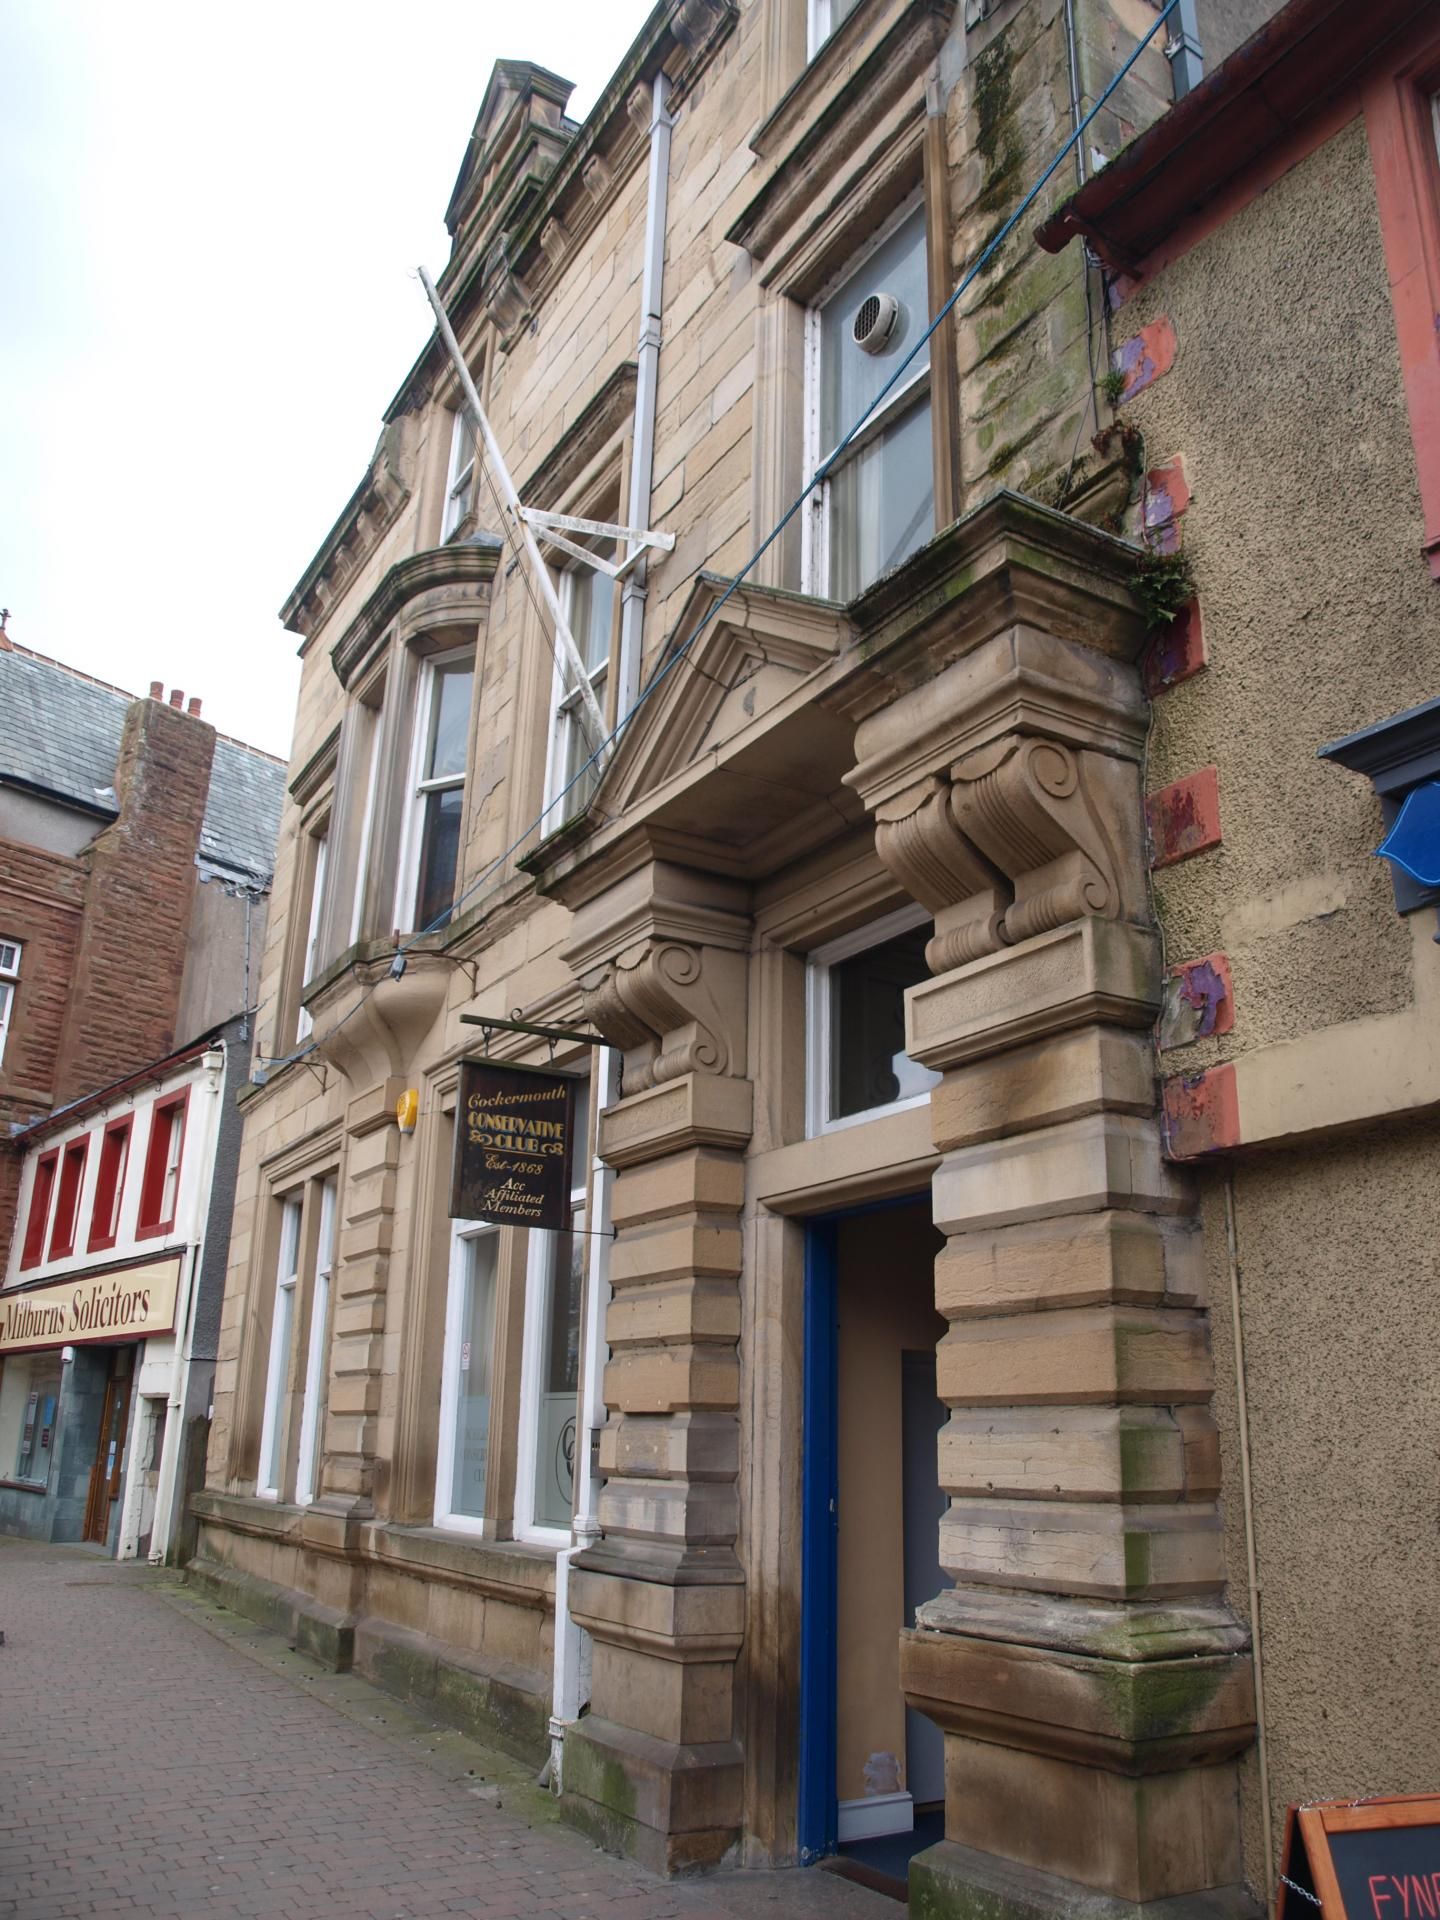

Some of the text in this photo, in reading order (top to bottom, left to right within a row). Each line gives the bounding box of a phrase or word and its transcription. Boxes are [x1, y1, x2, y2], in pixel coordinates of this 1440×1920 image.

[468, 1085, 566, 1109] Cockermouth
[468, 1111, 564, 1139] CONSERVATIVE
[495, 1134, 539, 1153] CLUB
[501, 1177, 526, 1191] Acc
[485, 1188, 544, 1205] Affiliated
[482, 1200, 542, 1217] Members
[3, 1282, 150, 1341] Milburns Solicitors
